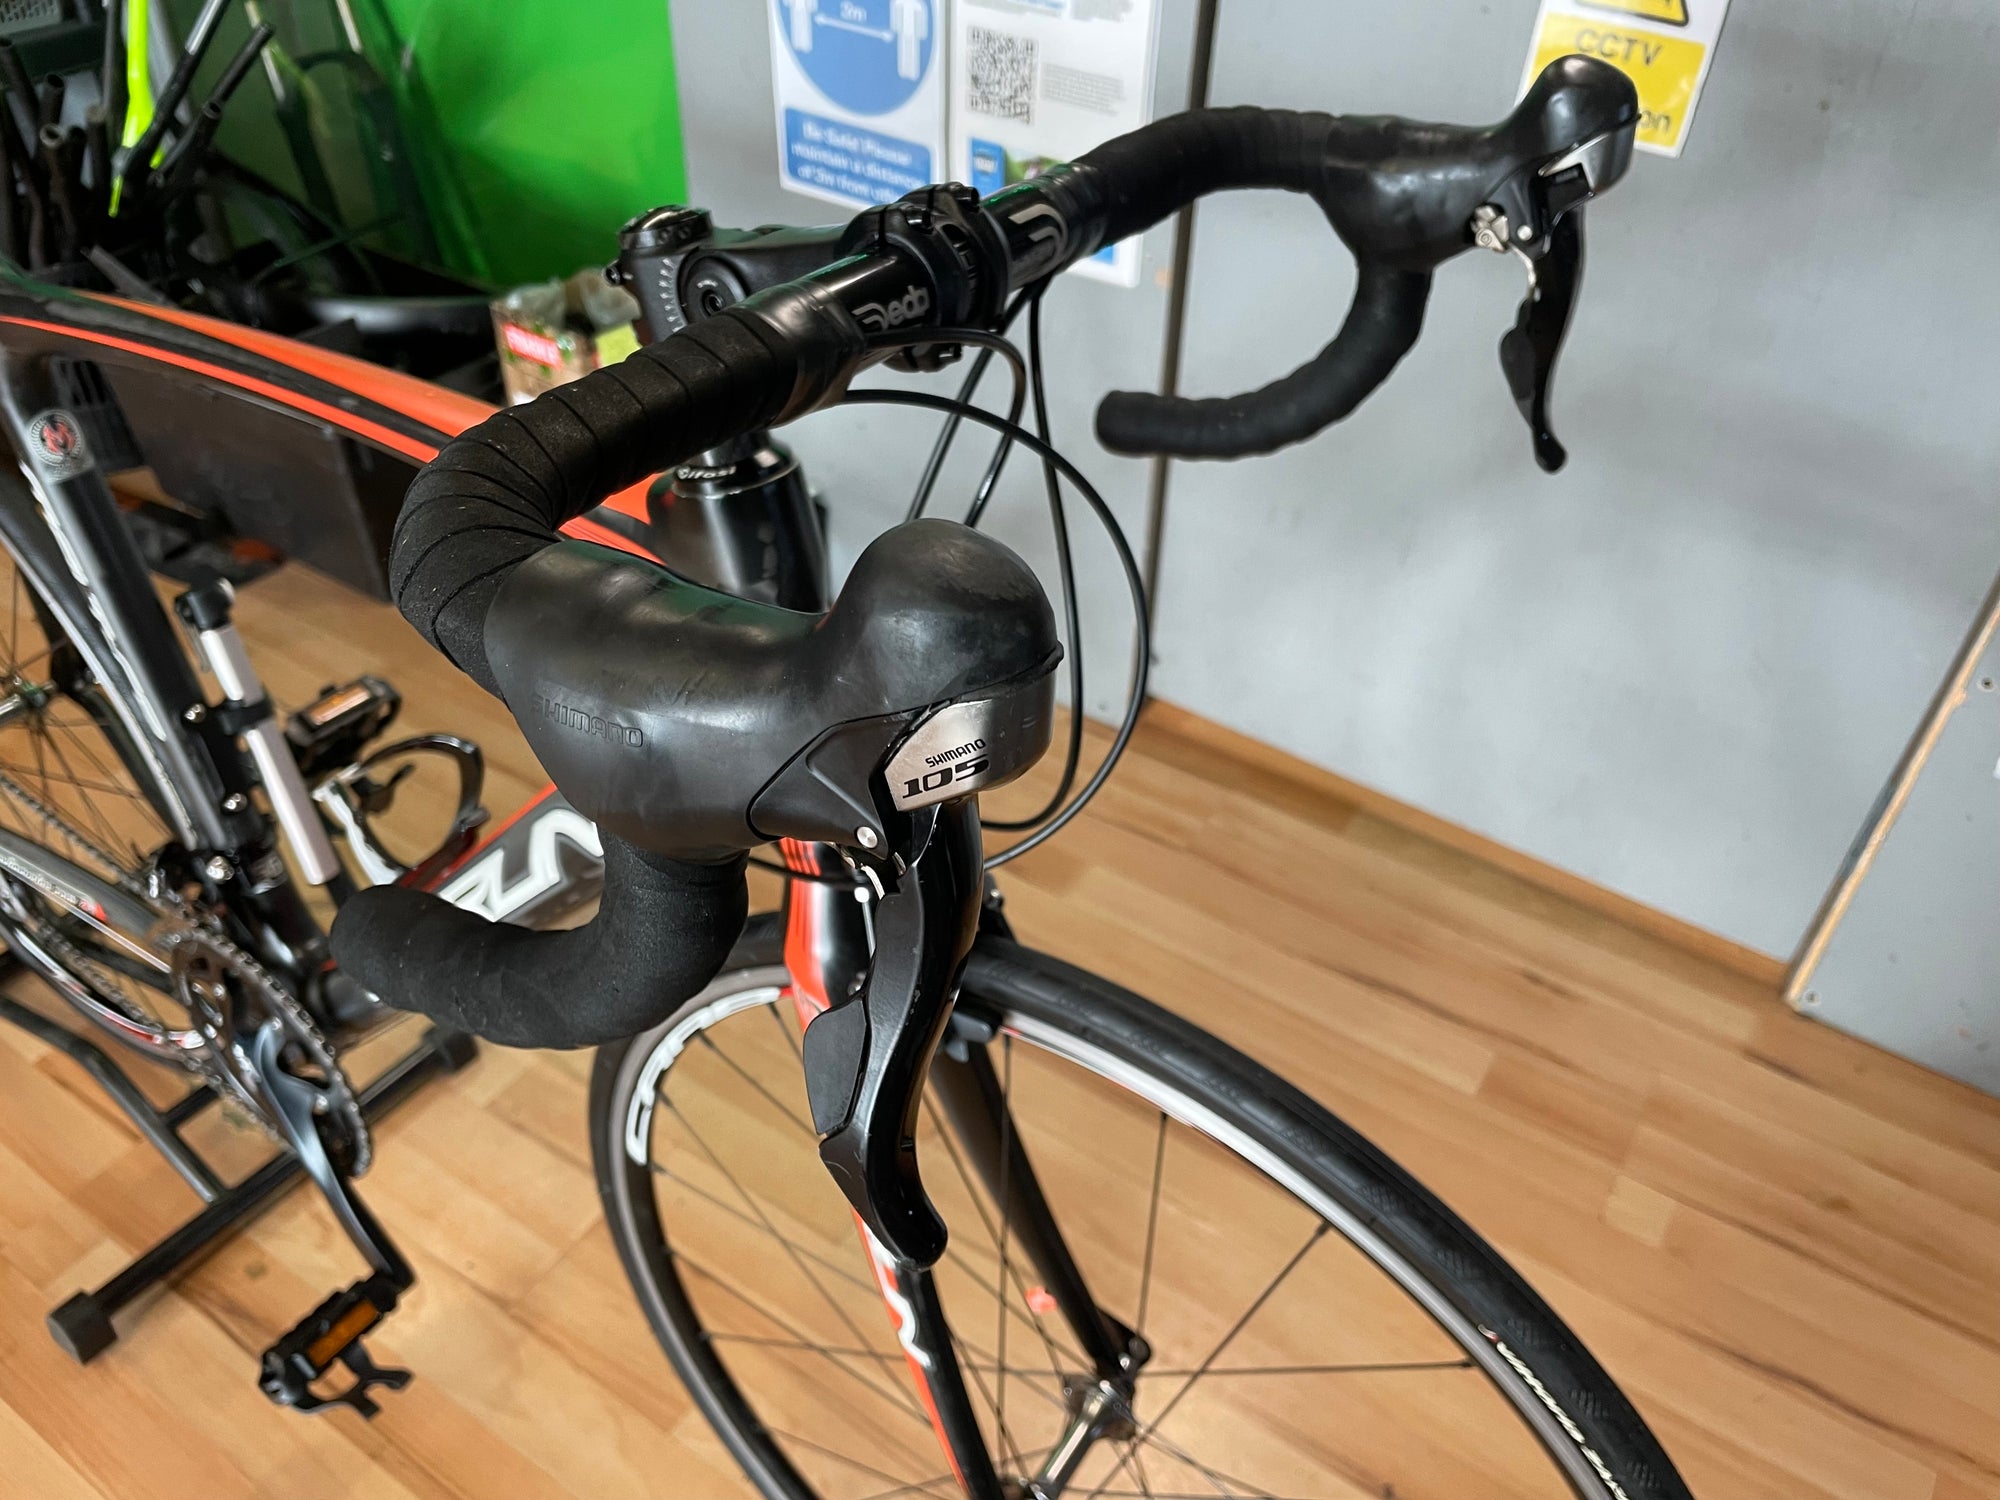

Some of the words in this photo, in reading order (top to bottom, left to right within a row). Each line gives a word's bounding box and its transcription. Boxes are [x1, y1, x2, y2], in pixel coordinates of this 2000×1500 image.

[840, 1, 867, 23] 2m
[1575, 28, 1664, 65] CCTV
[925, 738, 987, 768] SHIMANO
[902, 753, 990, 799] 105
